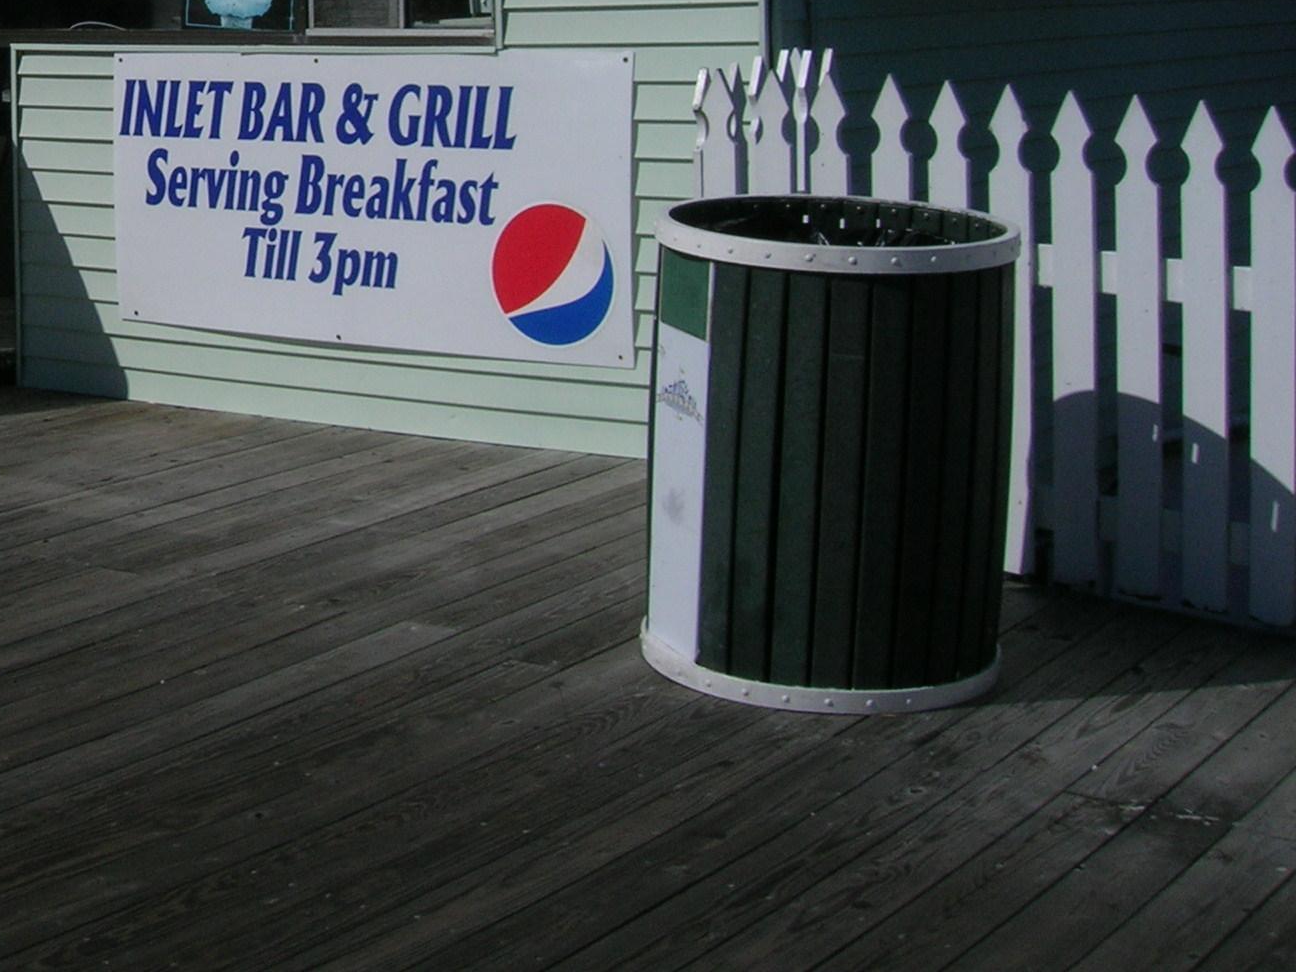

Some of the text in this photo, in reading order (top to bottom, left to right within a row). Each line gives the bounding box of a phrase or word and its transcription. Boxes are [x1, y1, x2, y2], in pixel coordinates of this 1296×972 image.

[119, 79, 517, 150] INLET BAR & GRILL
[146, 148, 499, 226] Serving Breakfast
[242, 227, 399, 295] Till 3pm
